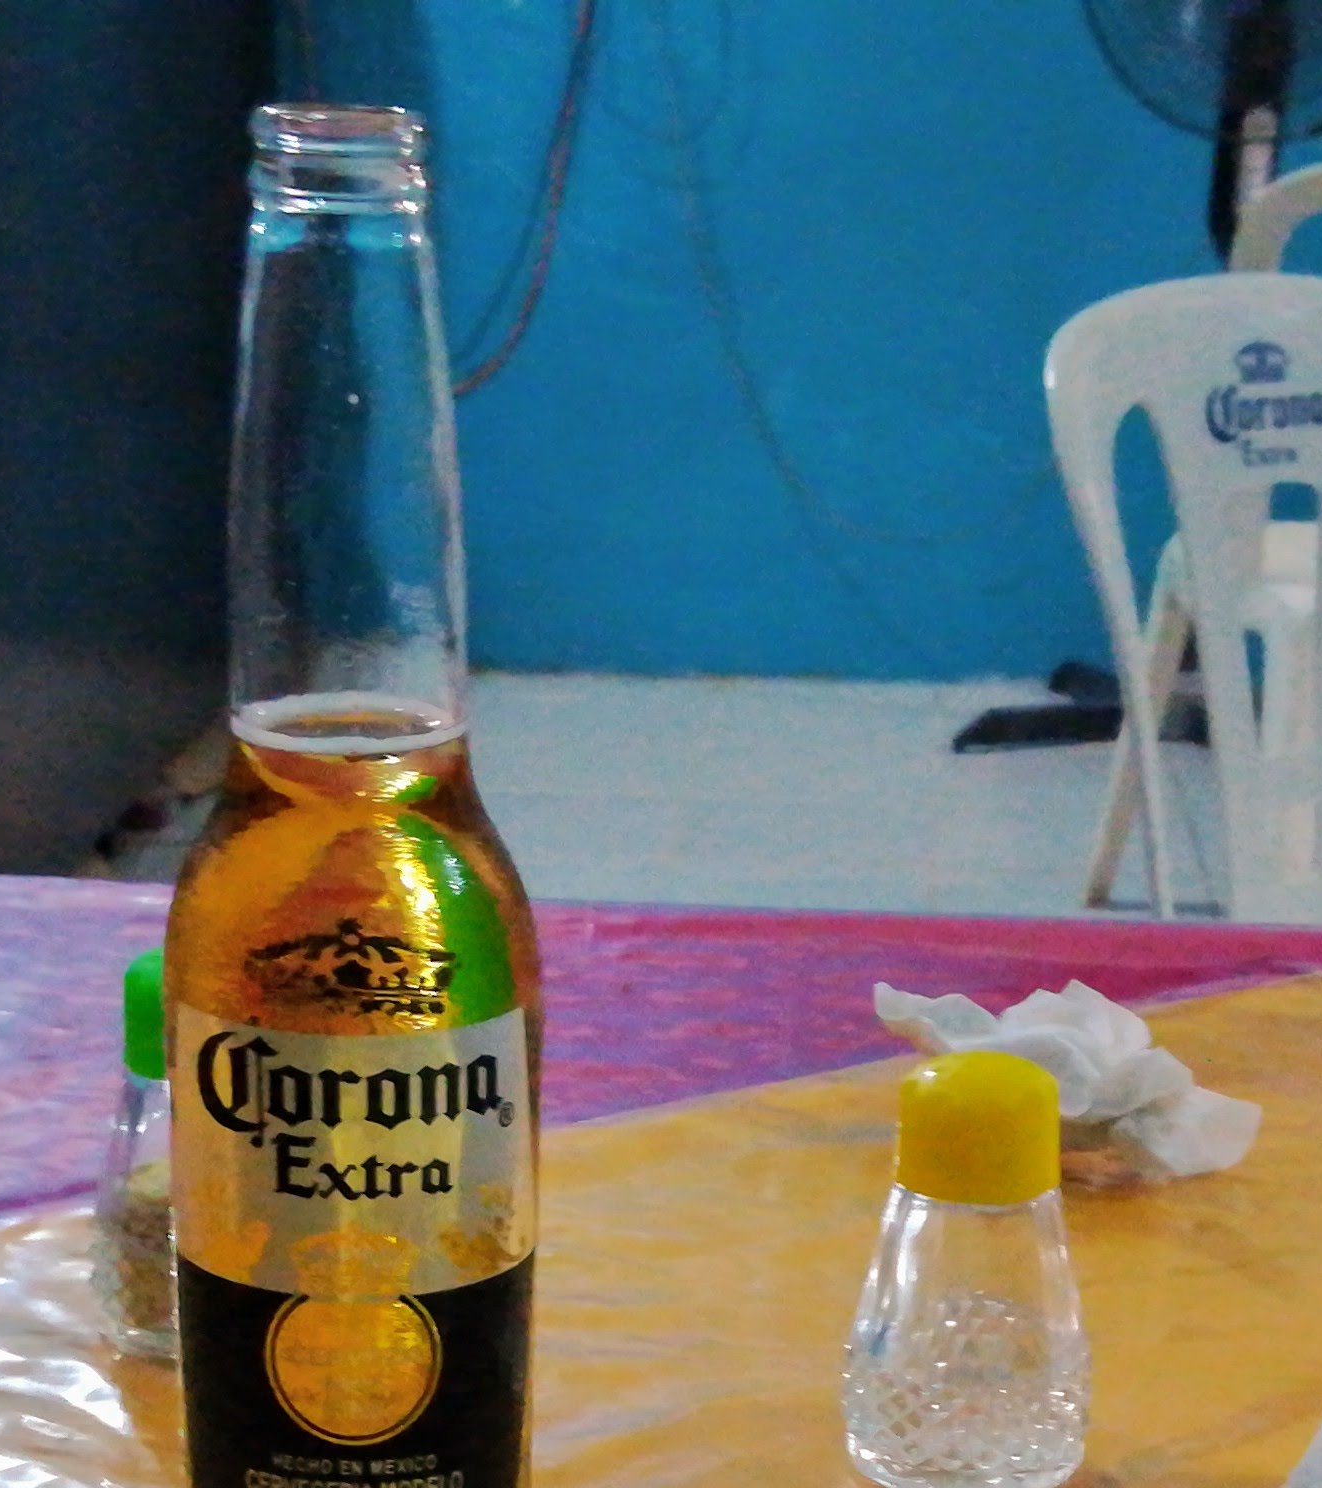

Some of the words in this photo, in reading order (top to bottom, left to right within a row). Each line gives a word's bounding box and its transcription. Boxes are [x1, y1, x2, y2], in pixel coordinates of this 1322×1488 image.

[197, 1030, 506, 1148] Corona
[274, 1133, 454, 1200] Extra
[271, 1452, 333, 1475] HECHO
[339, 1459, 364, 1475] EN
